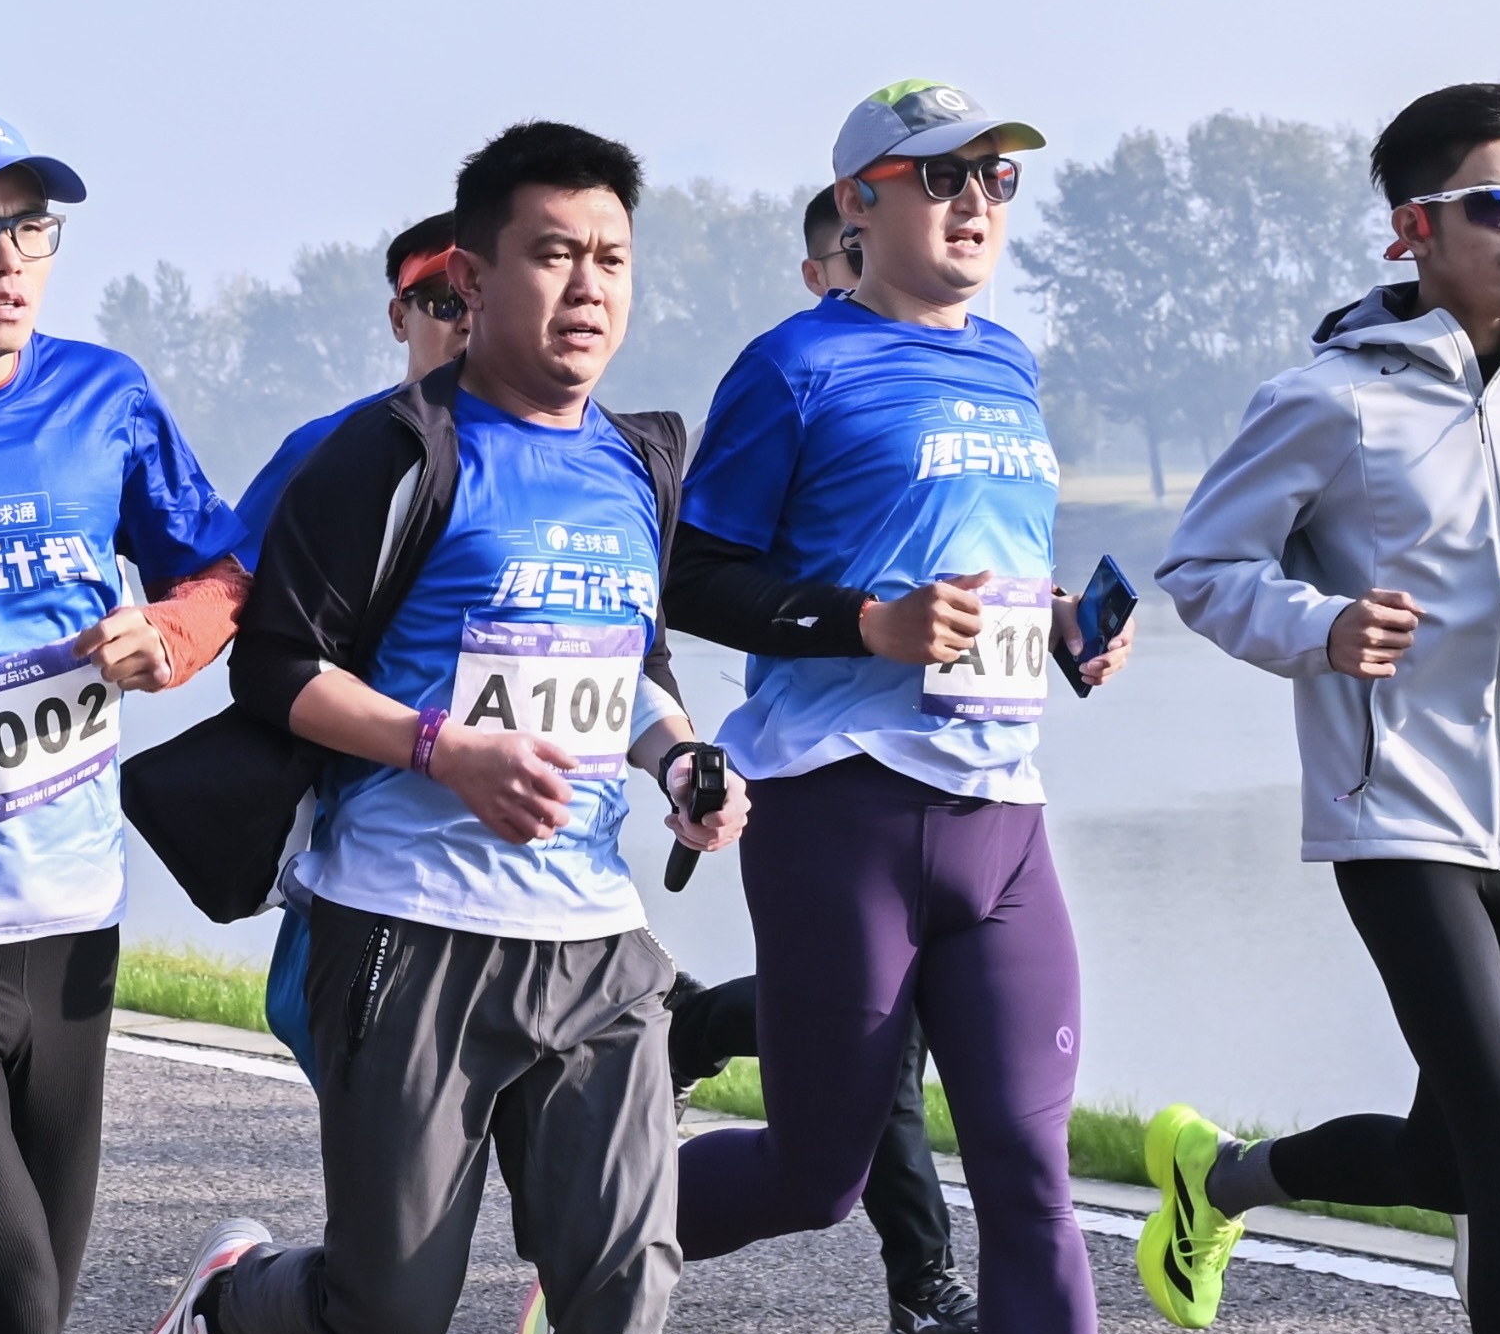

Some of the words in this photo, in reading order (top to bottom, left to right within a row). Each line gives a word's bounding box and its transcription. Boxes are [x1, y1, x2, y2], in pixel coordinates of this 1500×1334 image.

[978, 406, 1021, 425] 全球通
[571, 532, 620, 554] 全球通
[490, 562, 658, 621] 逐马计划
[464, 674, 627, 733] A106
